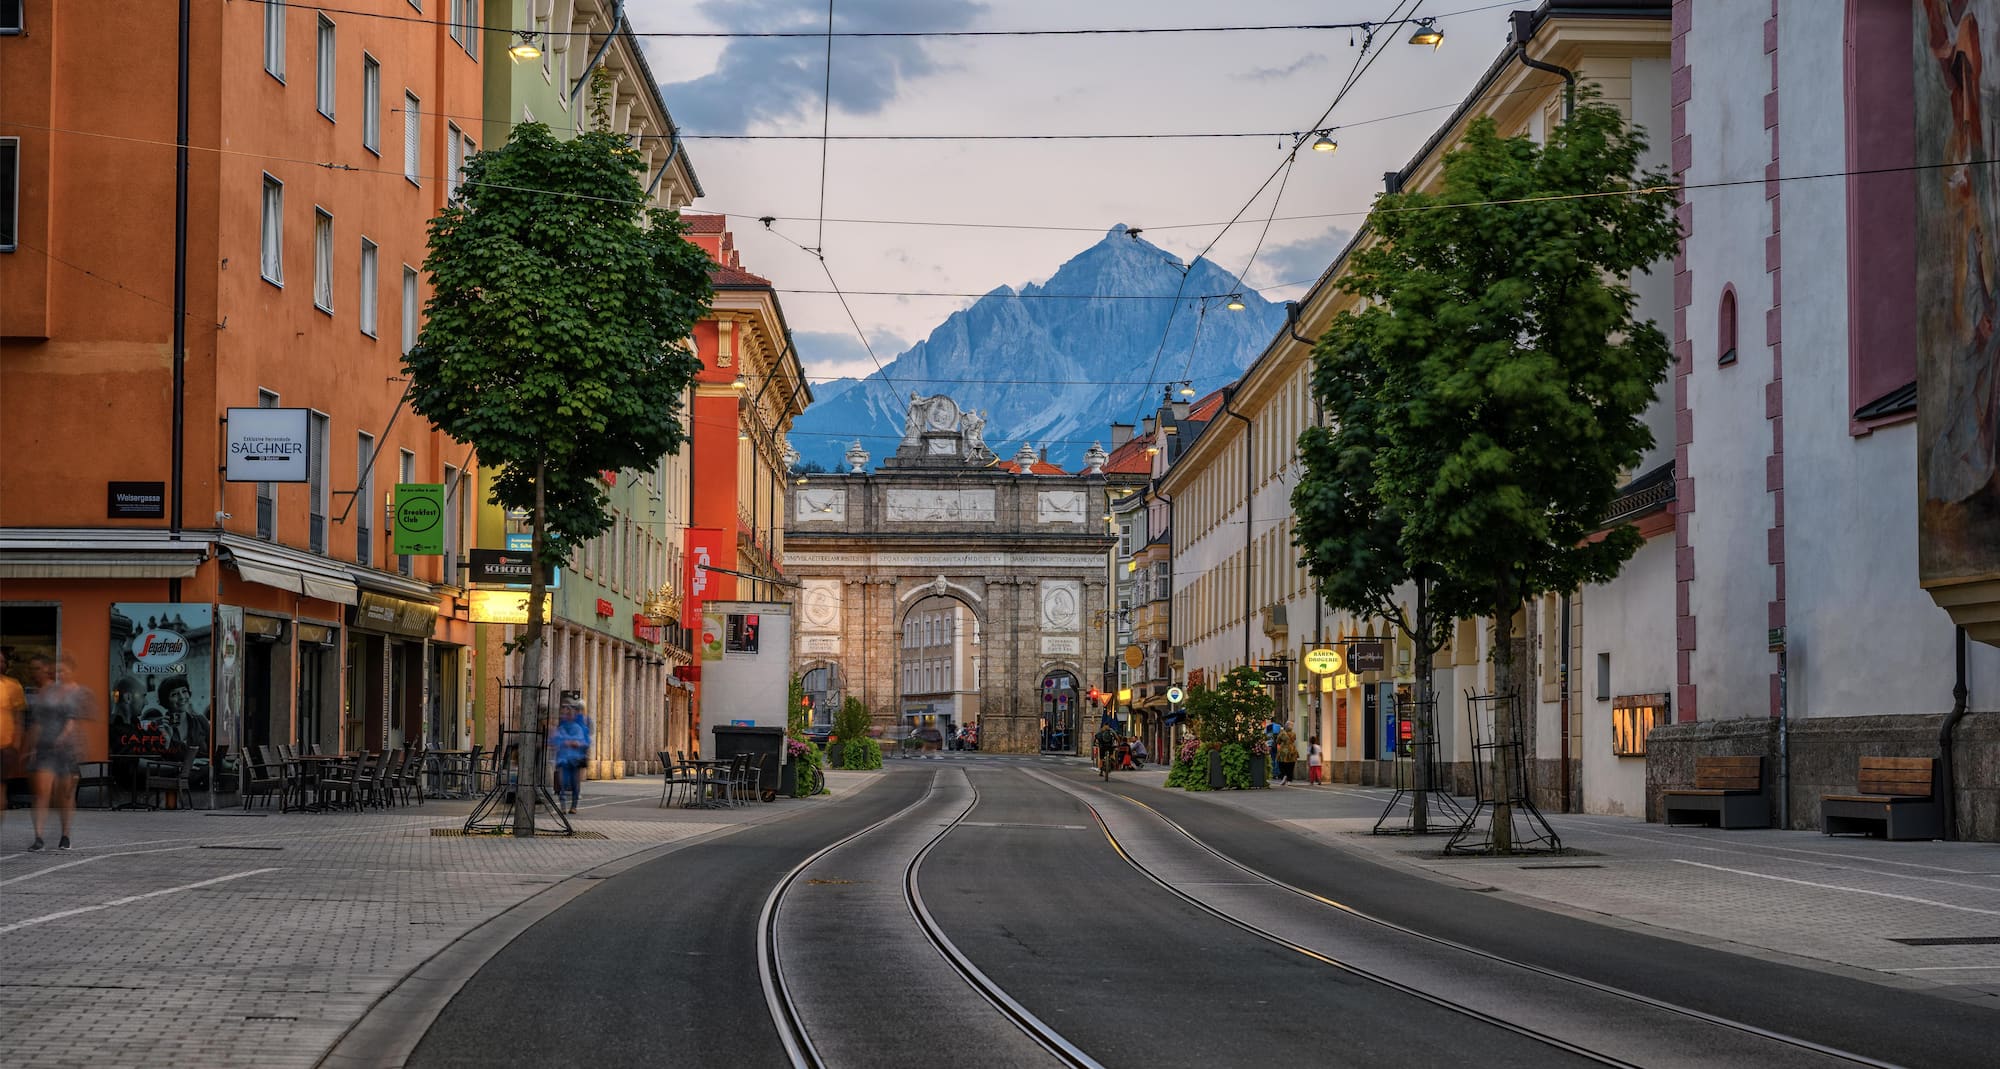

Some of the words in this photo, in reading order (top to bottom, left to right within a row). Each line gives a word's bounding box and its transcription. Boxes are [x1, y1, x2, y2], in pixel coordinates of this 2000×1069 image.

[231, 442, 302, 454] SALCHNER
[138, 634, 183, 656] Segafredo
[137, 664, 184, 673] ESPRESSO
